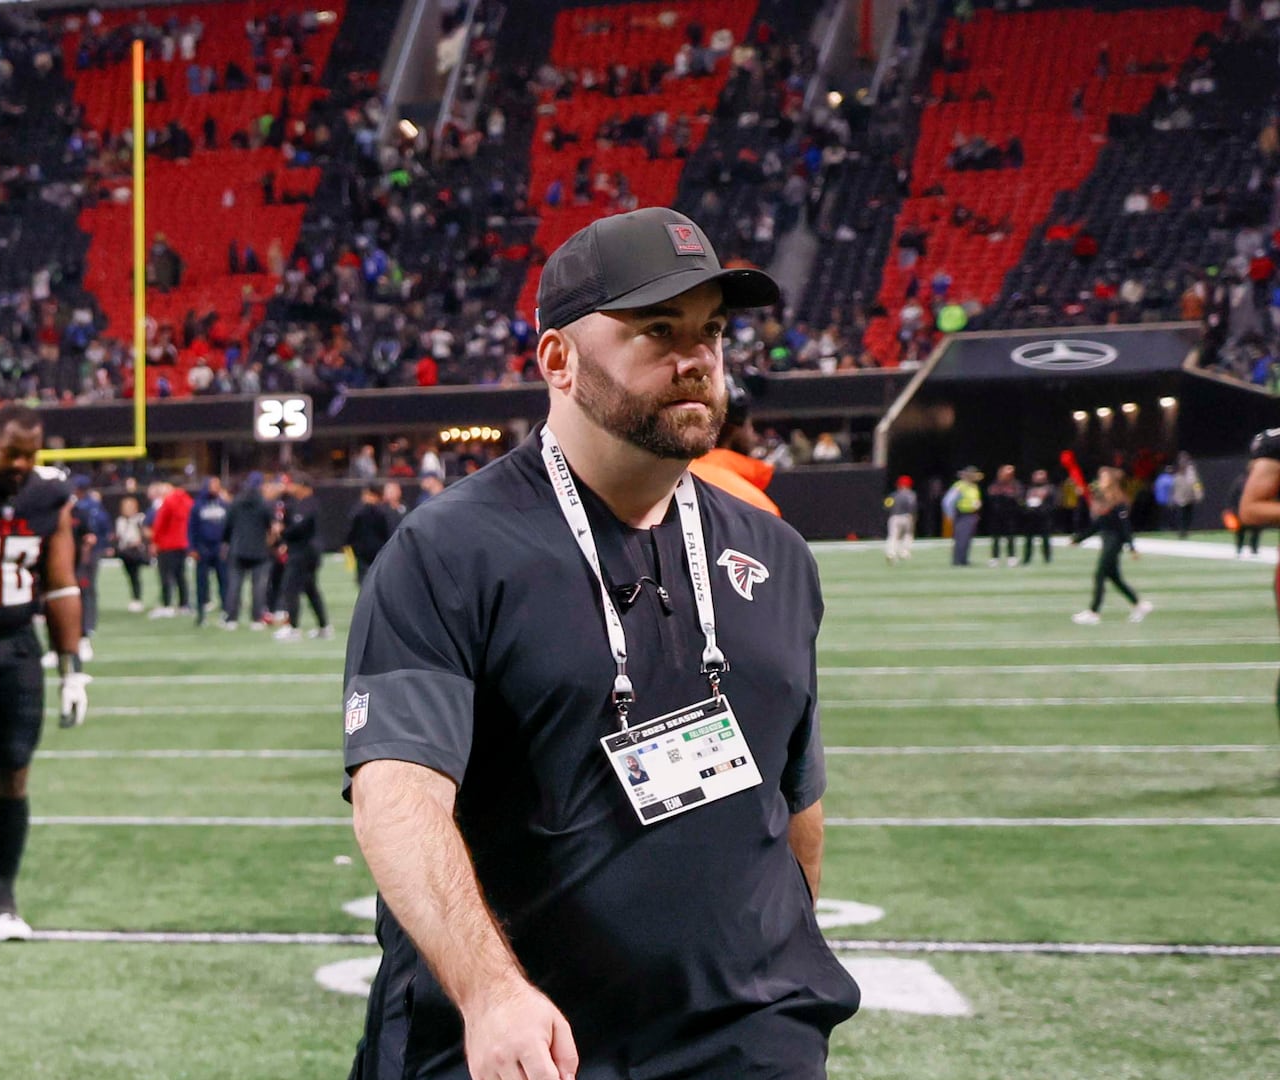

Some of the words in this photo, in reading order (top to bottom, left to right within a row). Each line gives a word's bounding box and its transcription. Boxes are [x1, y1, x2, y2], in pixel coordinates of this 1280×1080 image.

[258, 399, 308, 438] 25
[550, 445, 579, 506] FALCONS
[686, 532, 704, 602] FALCONS
[666, 710, 705, 729] SEASON
[662, 795, 683, 812] TEAM
